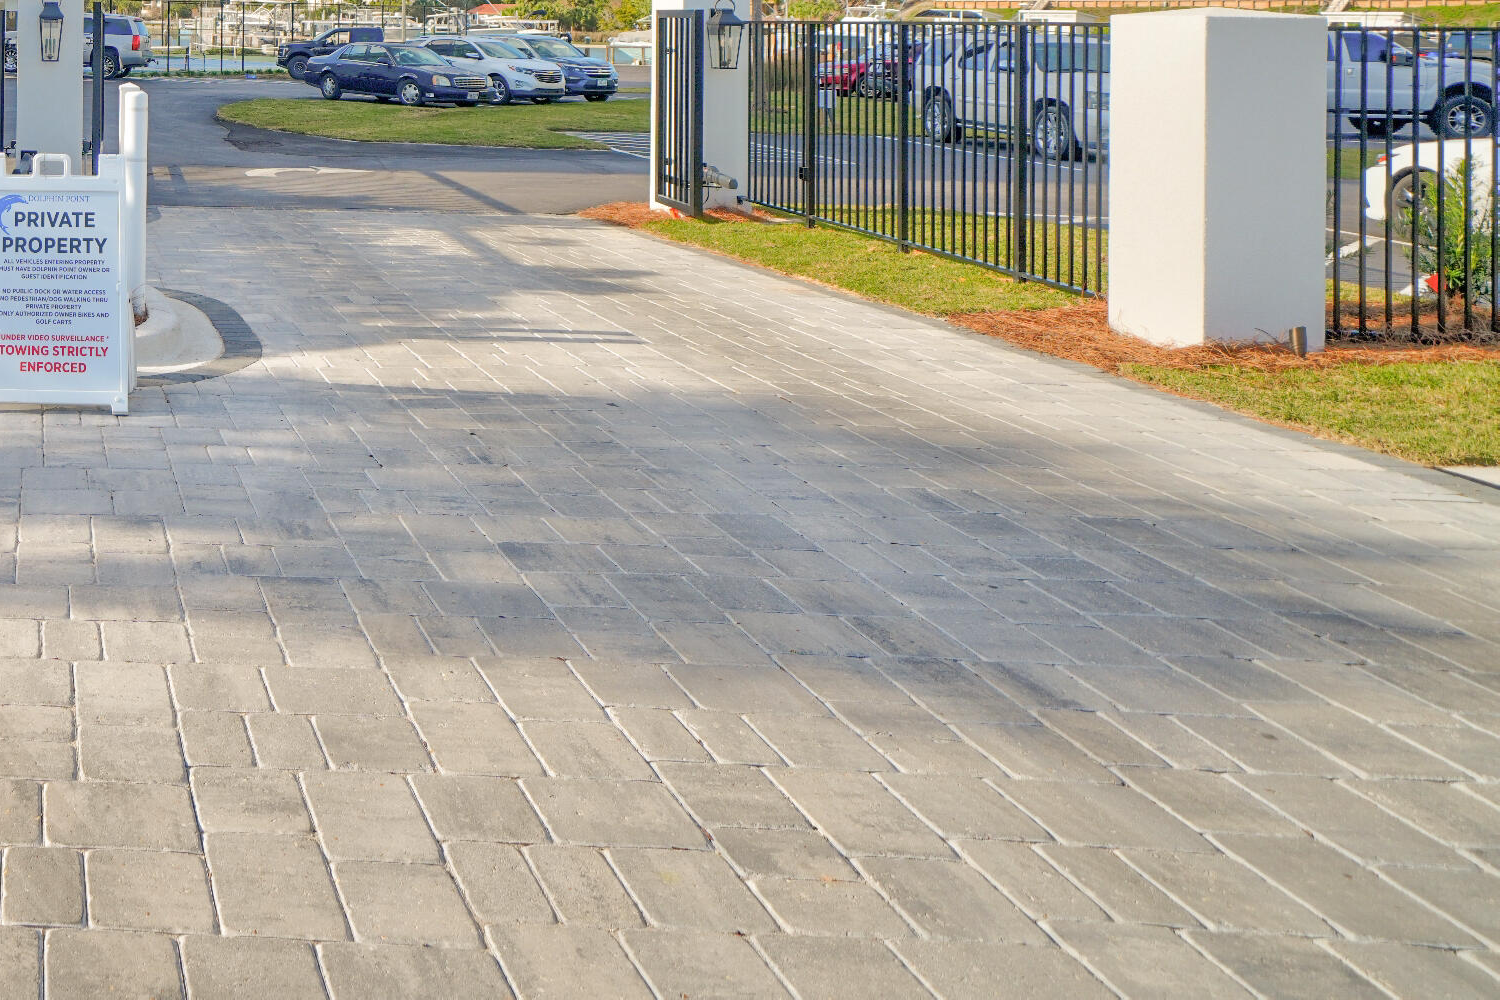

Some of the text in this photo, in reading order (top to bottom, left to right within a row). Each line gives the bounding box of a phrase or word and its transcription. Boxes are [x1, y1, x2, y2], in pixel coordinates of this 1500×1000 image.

[14, 212, 95, 227] PRIVATE
[2, 237, 107, 254] PROPERTY
[52, 345, 109, 357] STRICTLY
[20, 361, 87, 372] ENFORCED
